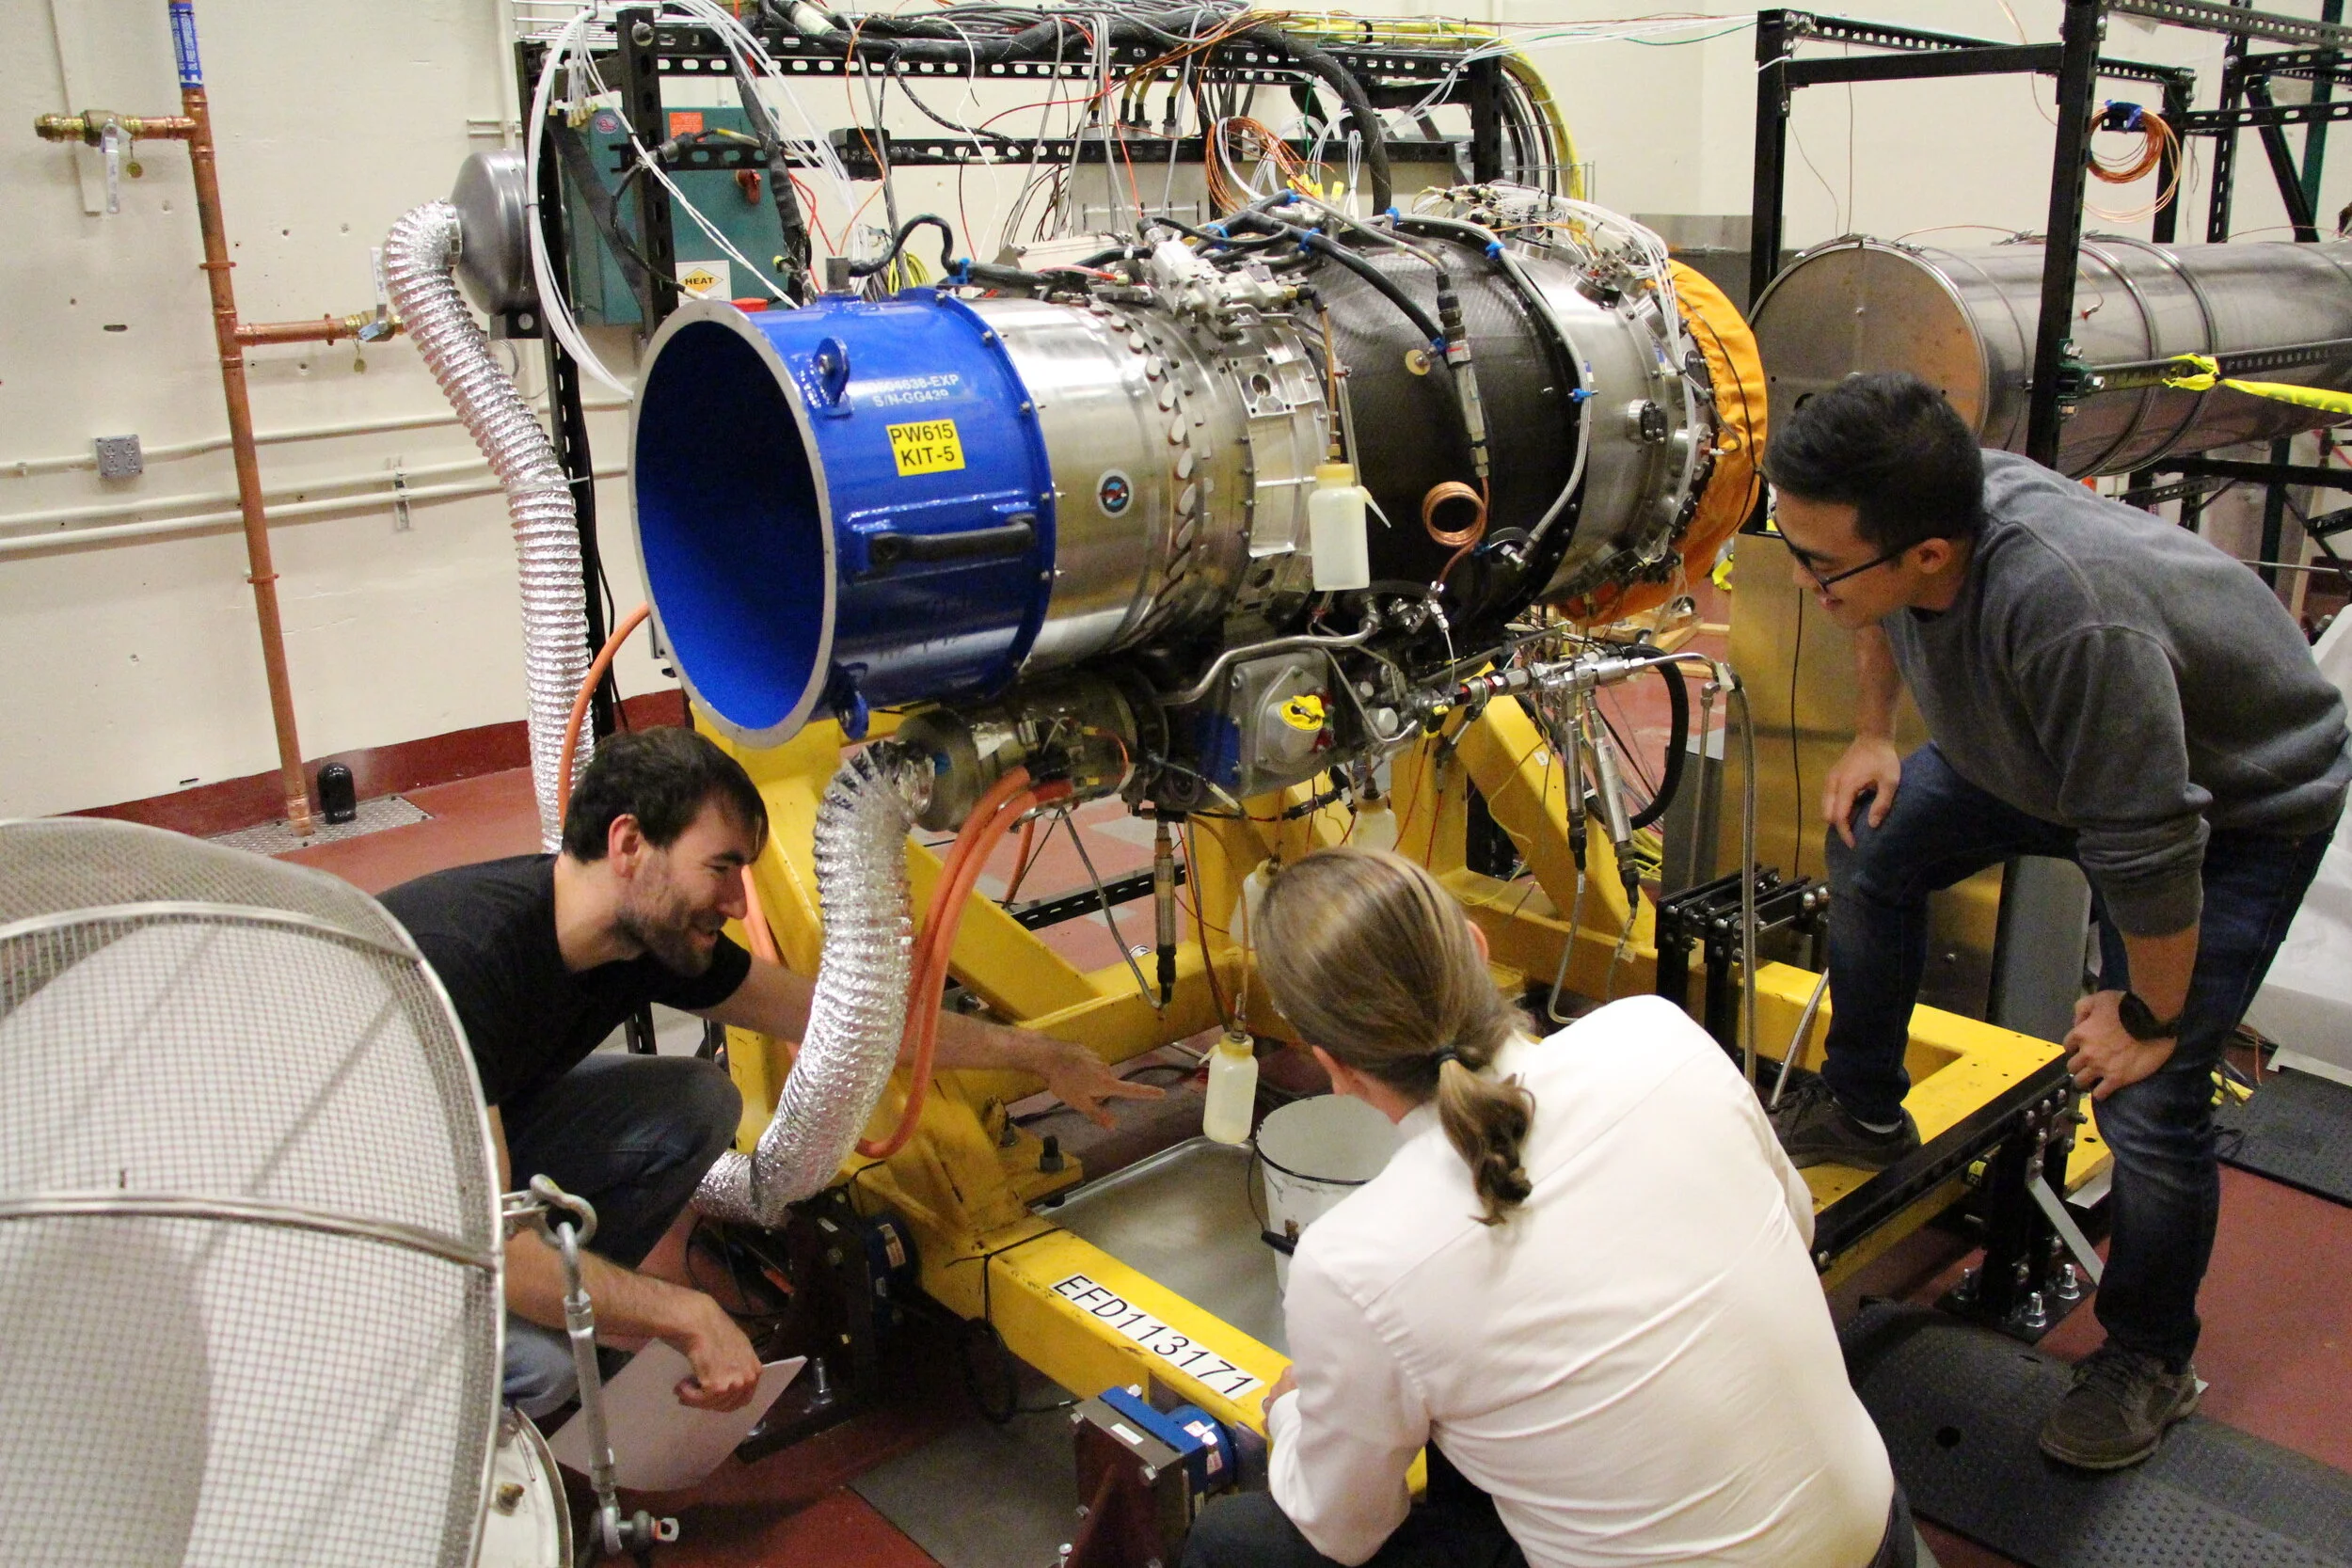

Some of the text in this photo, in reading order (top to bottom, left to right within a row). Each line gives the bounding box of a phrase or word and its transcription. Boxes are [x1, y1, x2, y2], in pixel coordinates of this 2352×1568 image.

[890, 422, 954, 444] PW615
[900, 446, 955, 467] KIT-5
[1053, 1275, 1254, 1395] EFD113171
